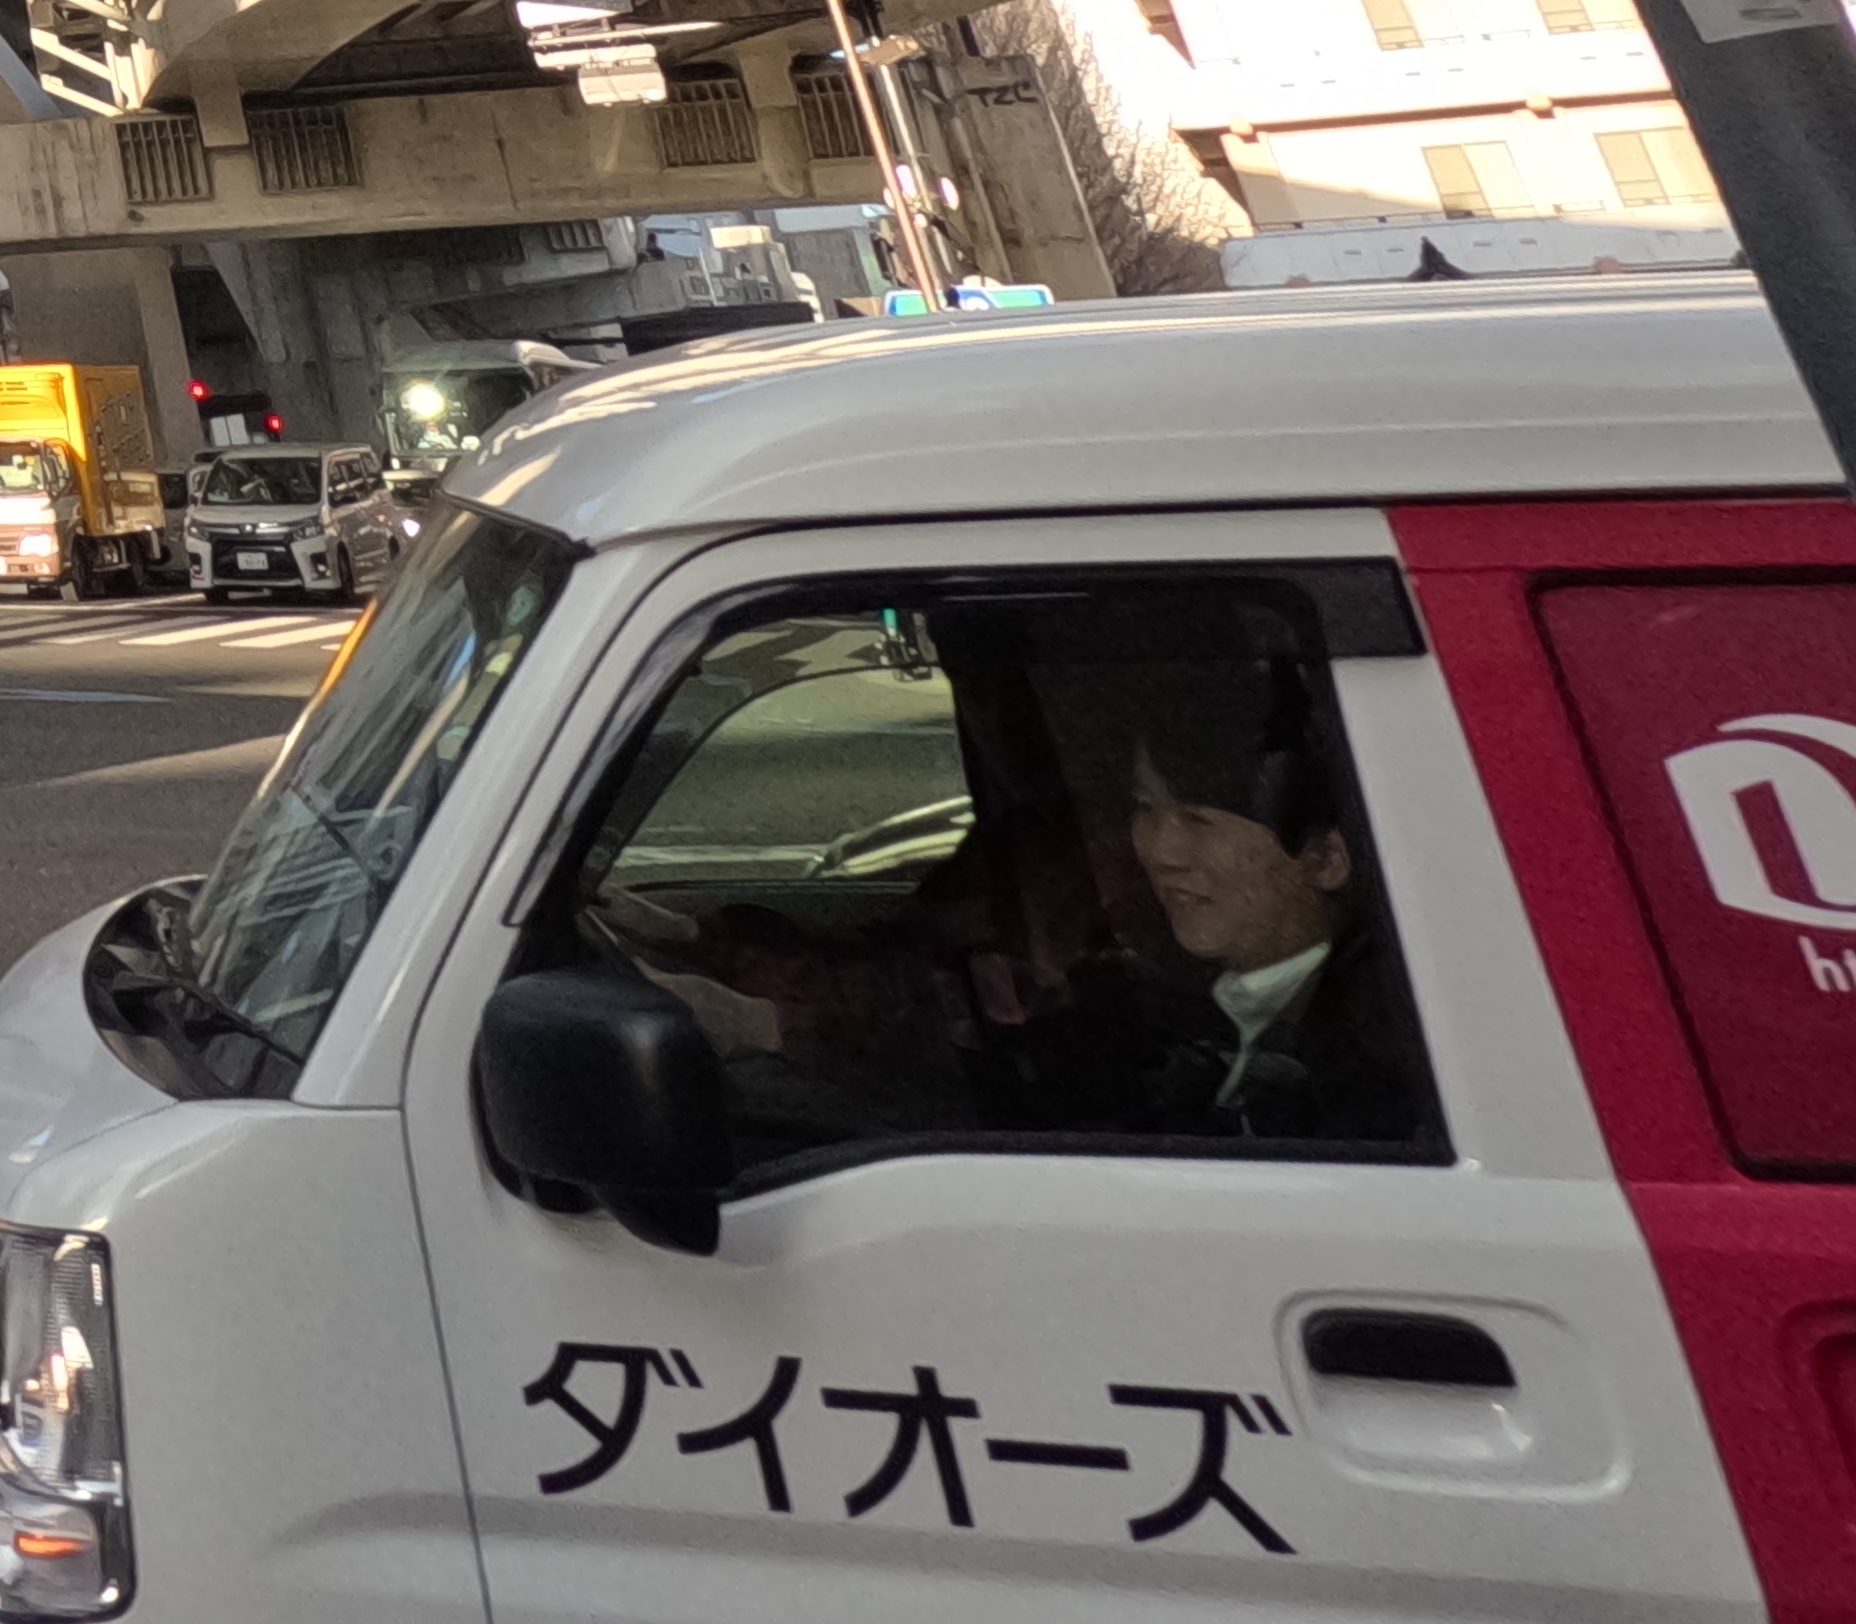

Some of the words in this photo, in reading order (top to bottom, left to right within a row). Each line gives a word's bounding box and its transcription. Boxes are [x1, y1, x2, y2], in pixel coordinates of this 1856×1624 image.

[522, 1340, 1298, 1554] ダイオーズ
